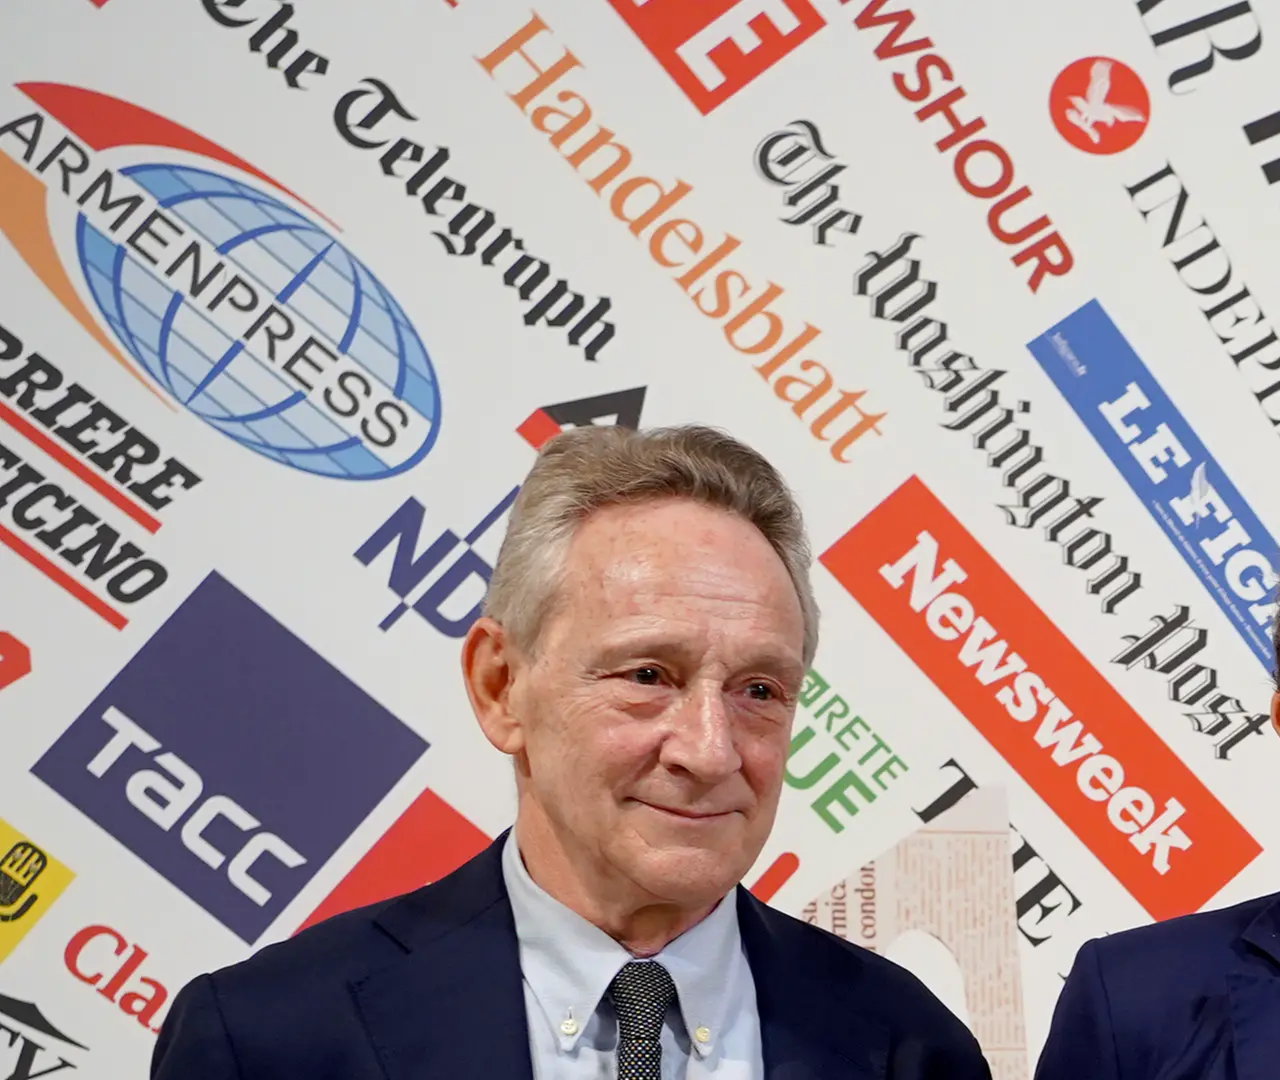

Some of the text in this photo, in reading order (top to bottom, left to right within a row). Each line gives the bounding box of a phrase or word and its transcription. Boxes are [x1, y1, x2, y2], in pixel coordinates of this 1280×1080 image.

[1, 112, 409, 448] ARMENPRESS
[333, 78, 616, 362] Telegraph
[472, 10, 888, 464] Handelsblatt
[838, 0, 1074, 294] WSHOUR
[0, 442, 169, 604] ICINO
[753, 119, 863, 247] The
[852, 231, 1144, 615] Washington
[1110, 604, 1270, 760] Post
[1098, 381, 1192, 485] LE
[813, 694, 909, 791] RETE
[879, 530, 1193, 875] Newsweek
[64, 924, 162, 1034] Cla
